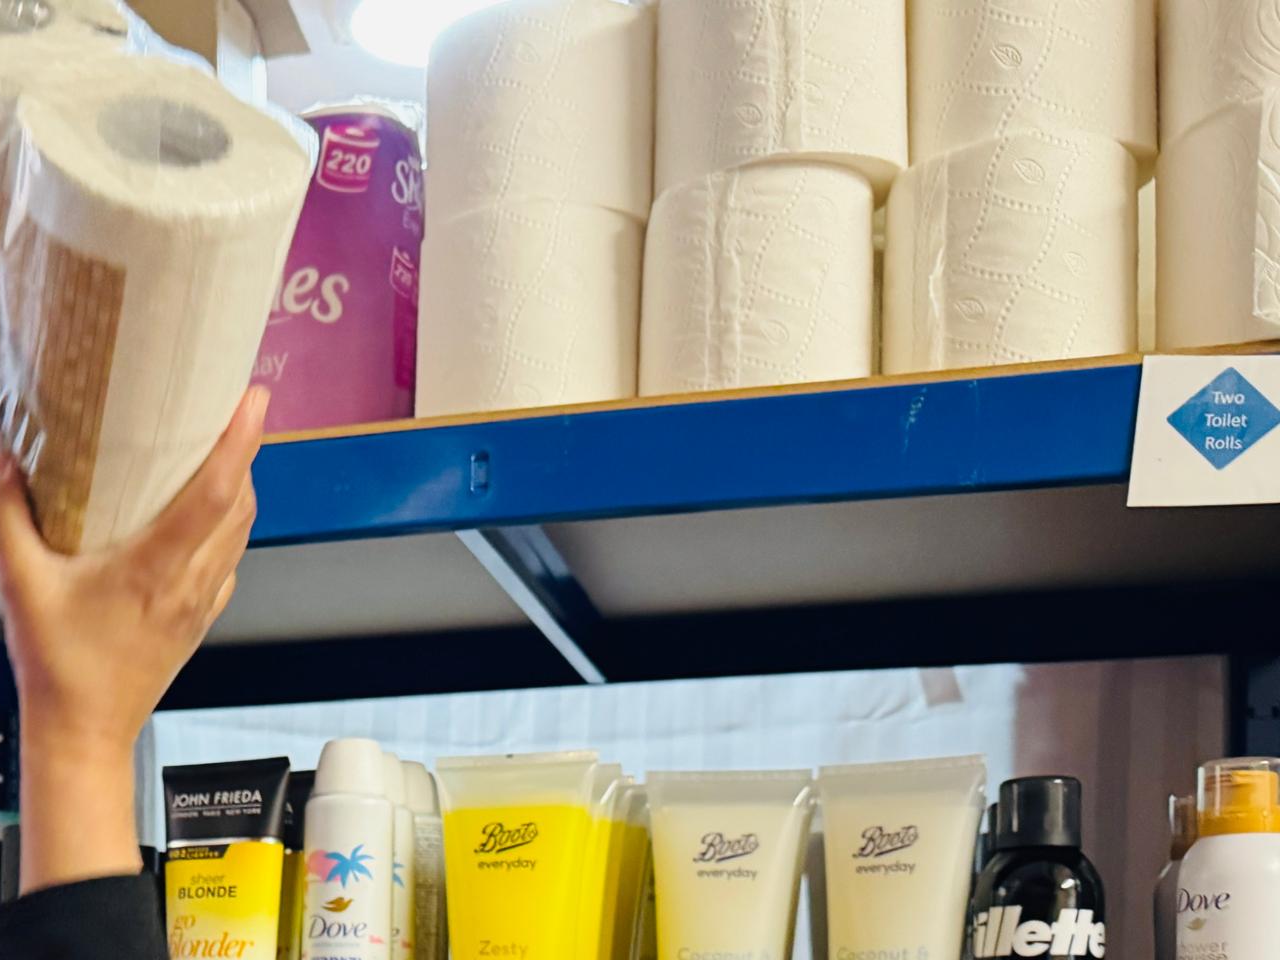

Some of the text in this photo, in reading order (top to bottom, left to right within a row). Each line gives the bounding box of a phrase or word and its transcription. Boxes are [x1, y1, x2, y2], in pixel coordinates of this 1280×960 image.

[326, 150, 371, 175] 220
[1212, 391, 1245, 404] Two
[1204, 413, 1248, 427] Toilet
[1205, 436, 1242, 450] Rolls
[173, 790, 262, 808] JOHN FRIEDA
[474, 821, 539, 854] Boots
[852, 824, 919, 858] Boots
[692, 832, 760, 863] Boots
[477, 857, 537, 870] everyday
[856, 860, 916, 876] everyday
[697, 867, 757, 880] everyday
[178, 886, 238, 899] BLONDE
[308, 913, 367, 939] Dove
[479, 940, 529, 960] Zesty
